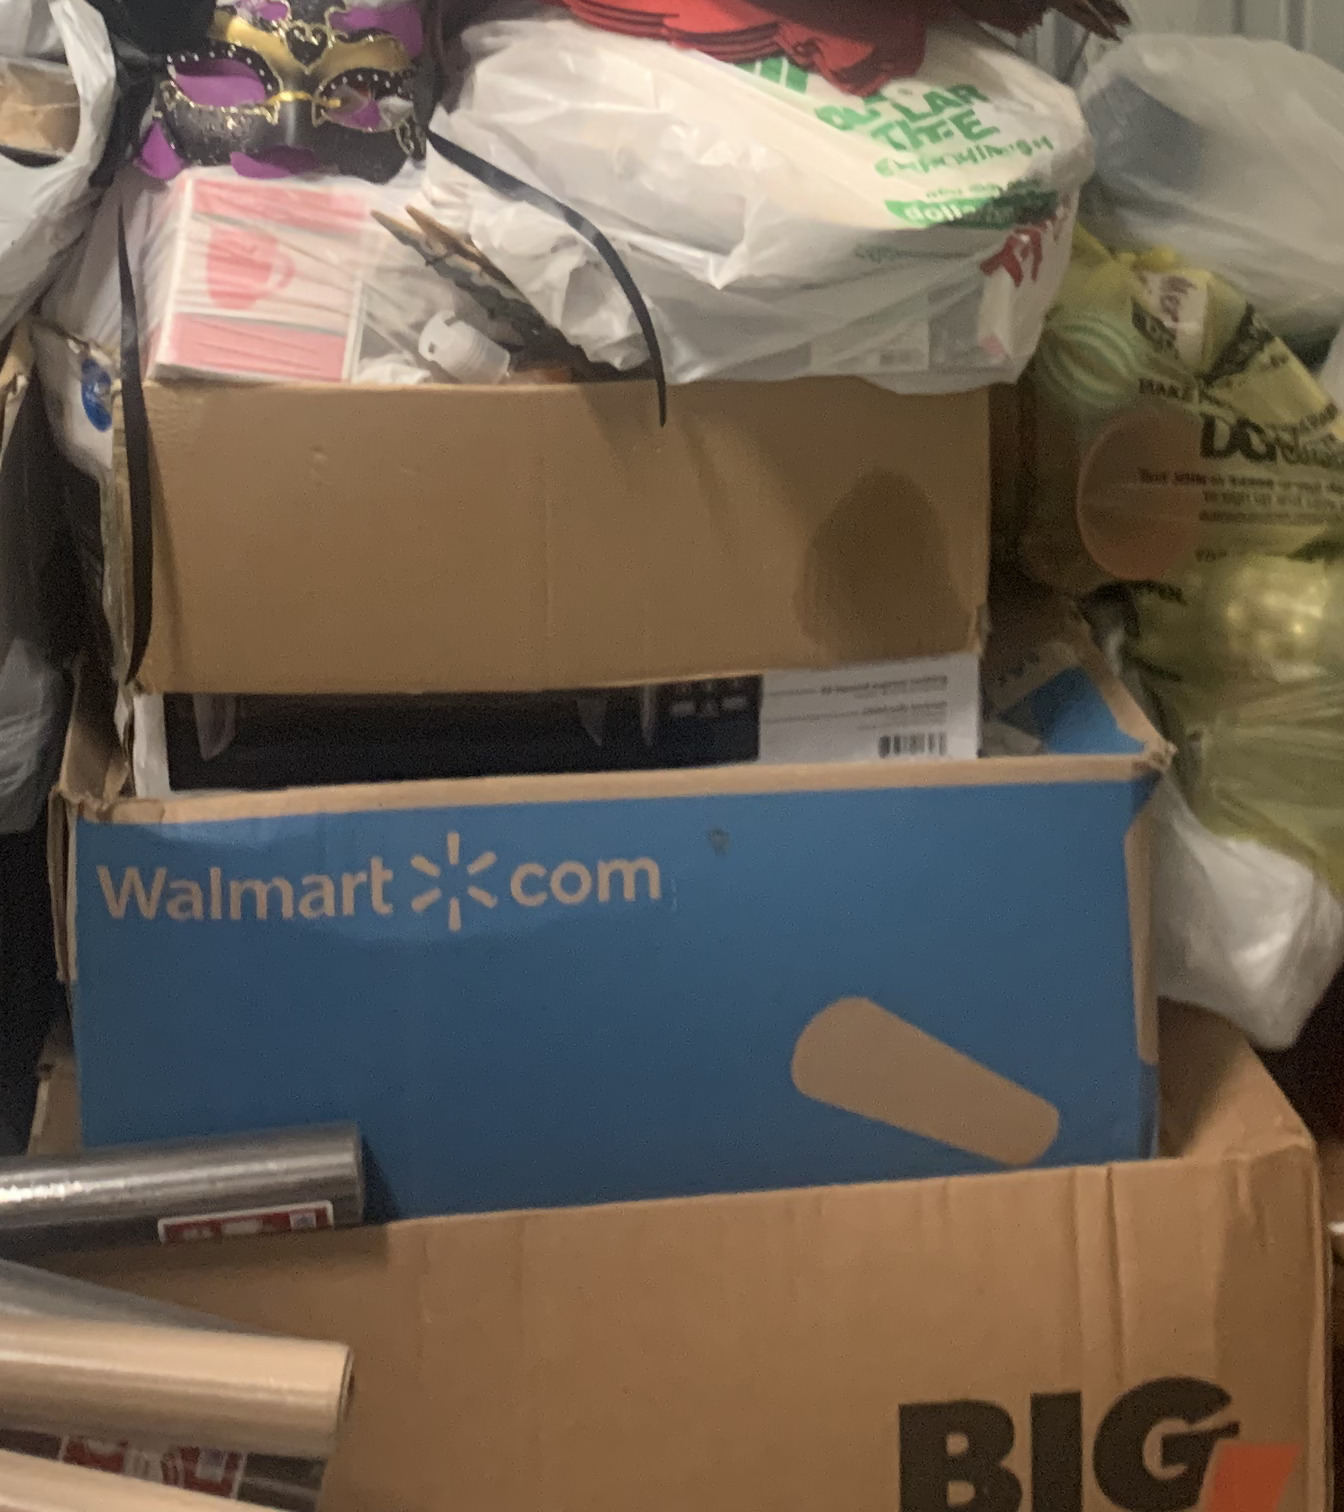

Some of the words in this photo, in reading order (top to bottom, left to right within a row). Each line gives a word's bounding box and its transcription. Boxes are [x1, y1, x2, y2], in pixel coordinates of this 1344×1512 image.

[95, 856, 394, 922] Walmart
[509, 856, 662, 908] com
[898, 1375, 1241, 1512] BIG
